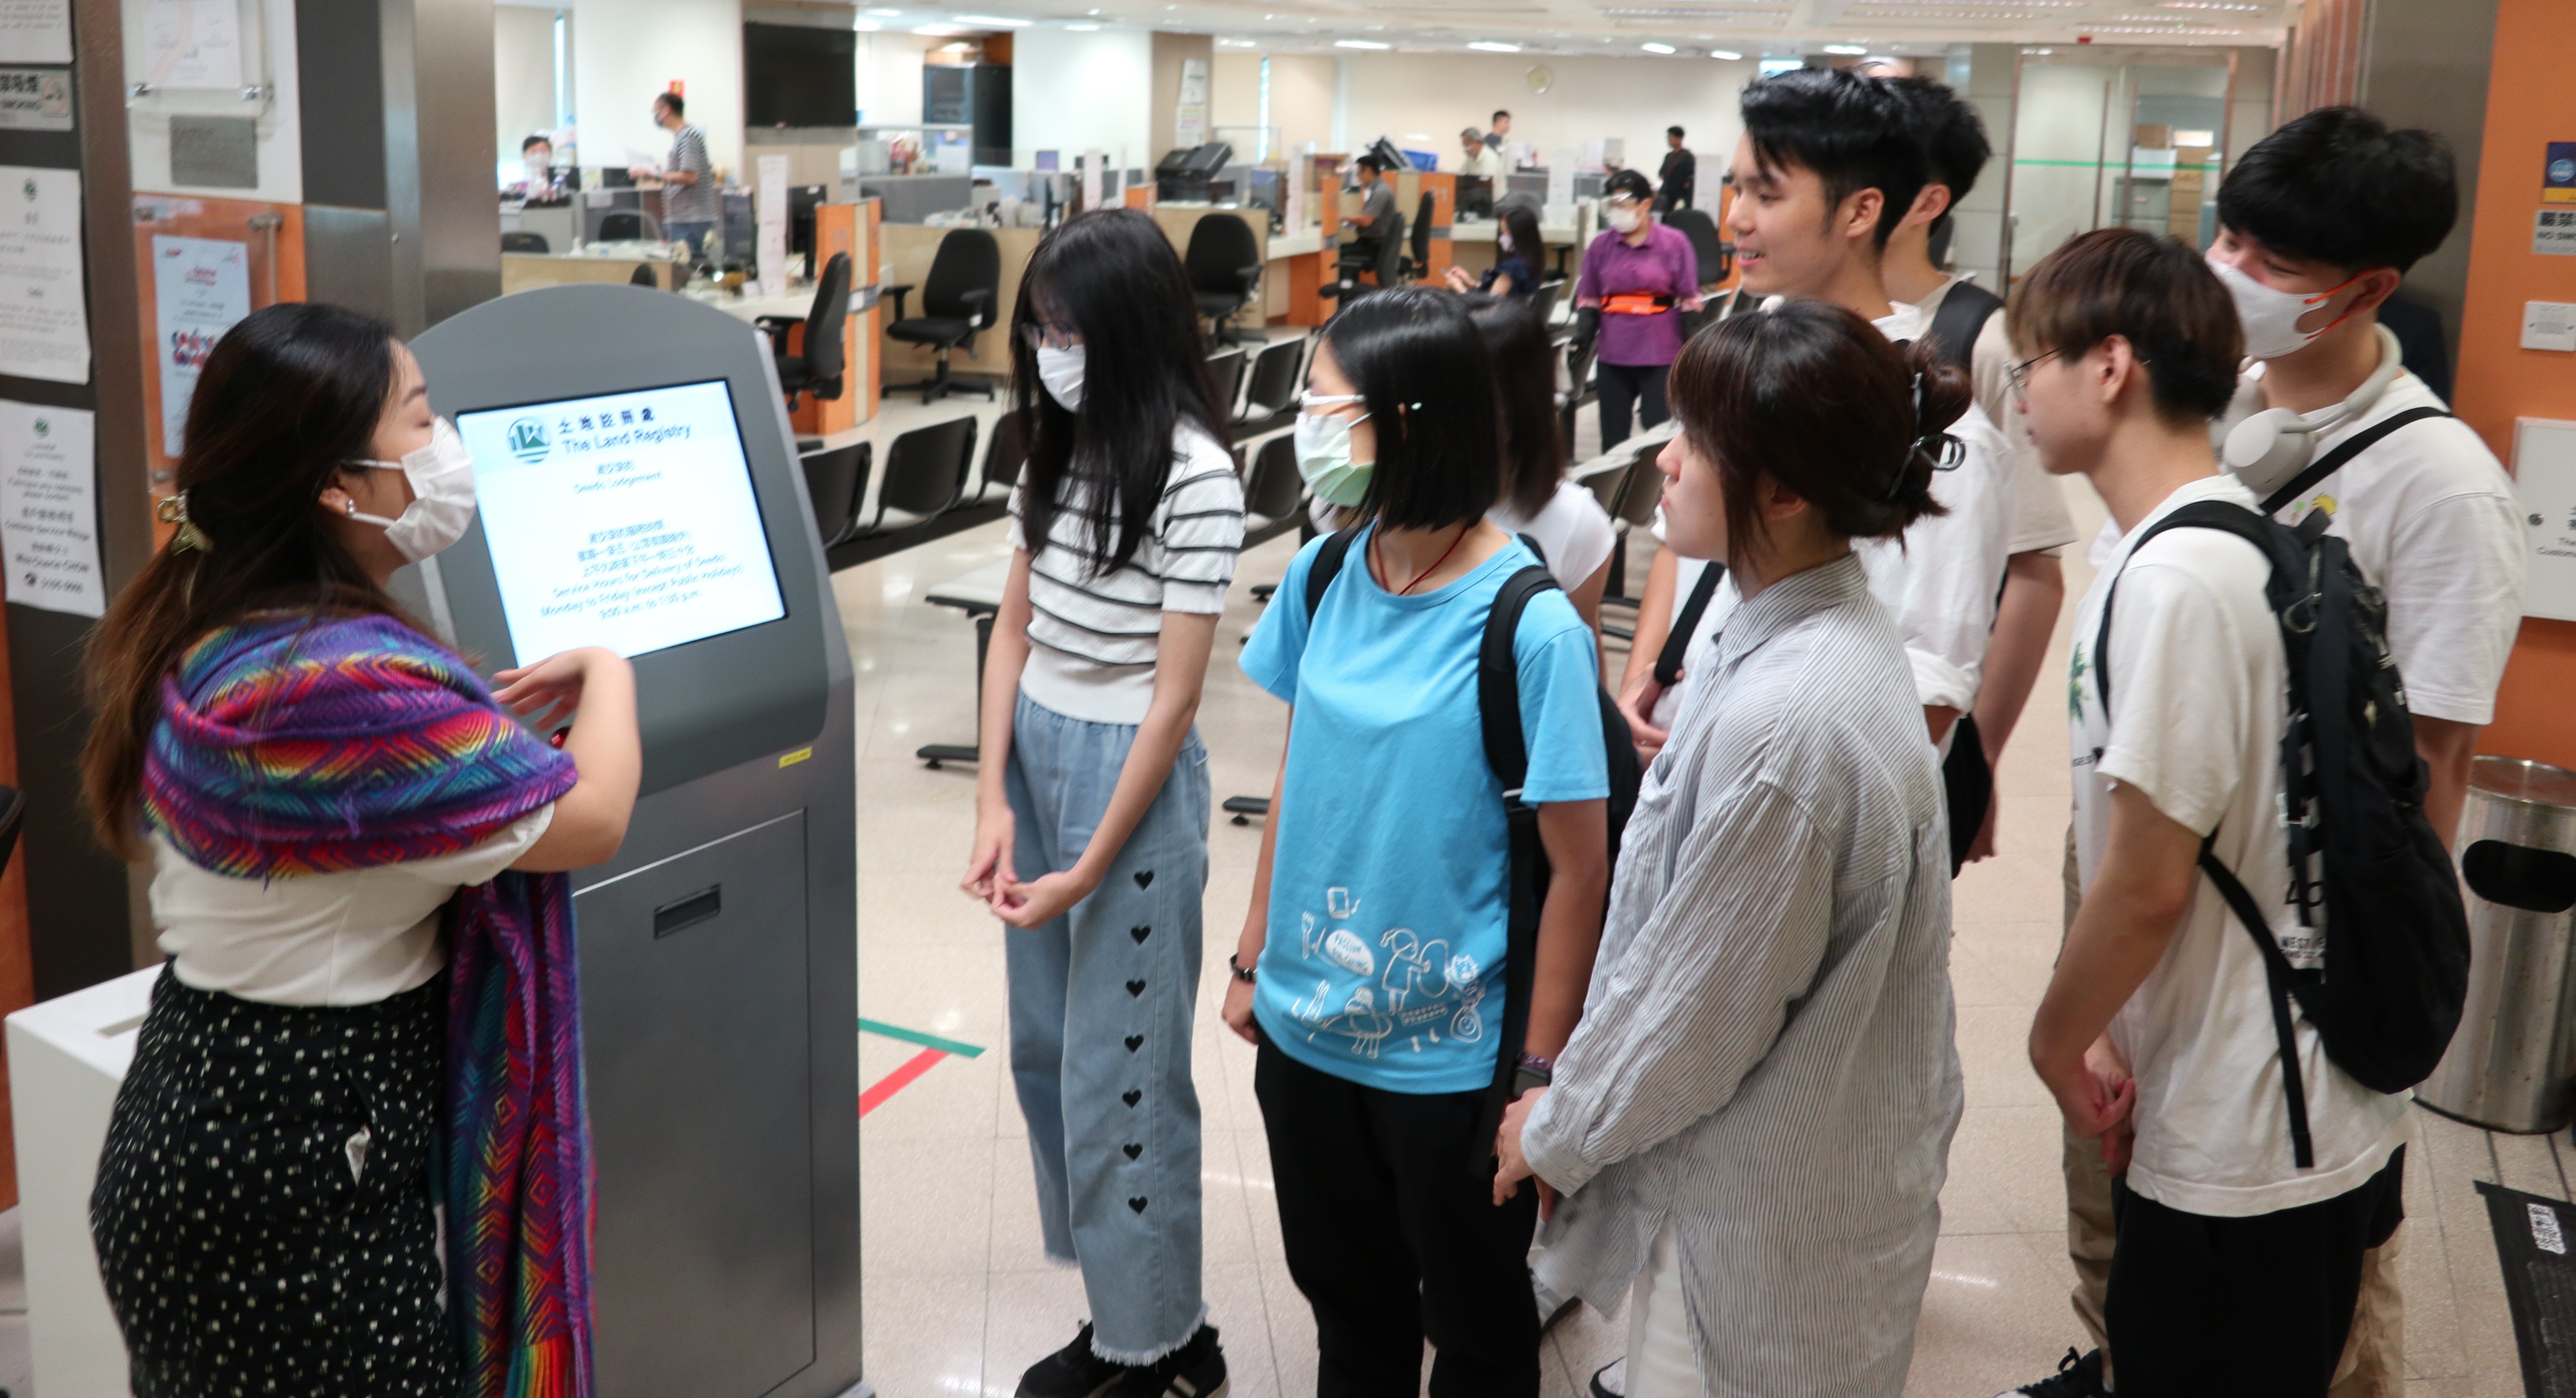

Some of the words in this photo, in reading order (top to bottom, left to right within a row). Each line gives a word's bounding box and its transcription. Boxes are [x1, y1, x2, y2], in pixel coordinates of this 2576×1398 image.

[2540, 212, 2576, 227] 嚴禁
[559, 407, 655, 435] 土地註冊處
[562, 438, 591, 454] The
[594, 430, 631, 450] Land
[634, 424, 691, 444] Registry
[541, 603, 583, 617] Monday
[599, 591, 630, 606] Friday
